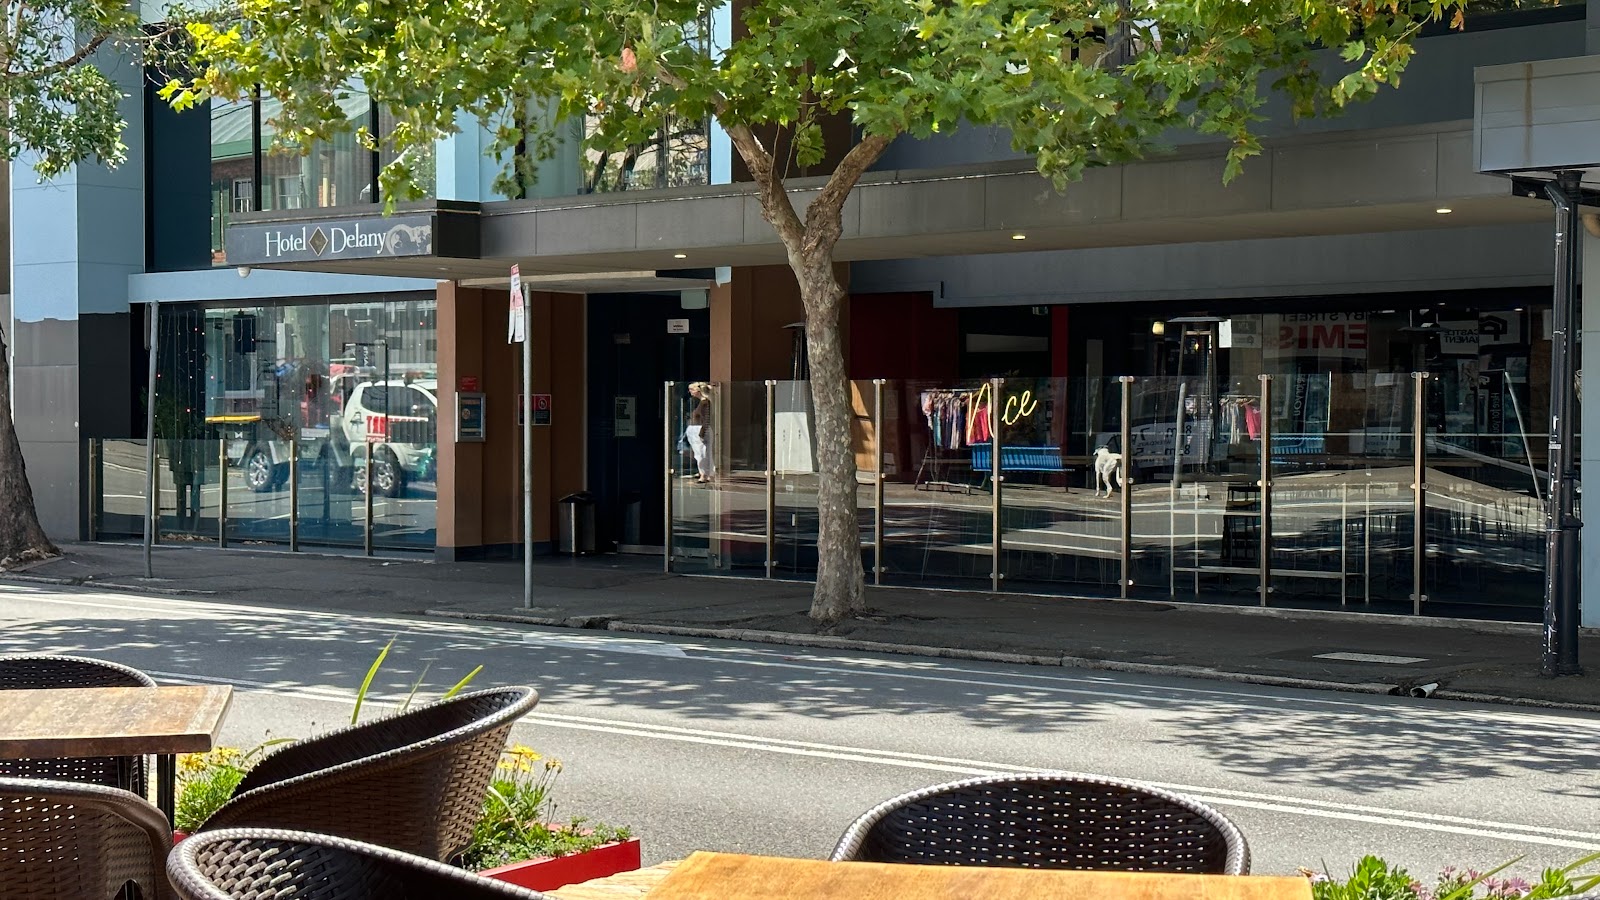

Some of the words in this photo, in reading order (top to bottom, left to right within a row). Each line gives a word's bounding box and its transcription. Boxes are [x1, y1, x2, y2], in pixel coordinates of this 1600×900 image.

[264, 226, 307, 257] Hotel
[330, 223, 387, 255] Delany
[966, 382, 1038, 444] Nce
